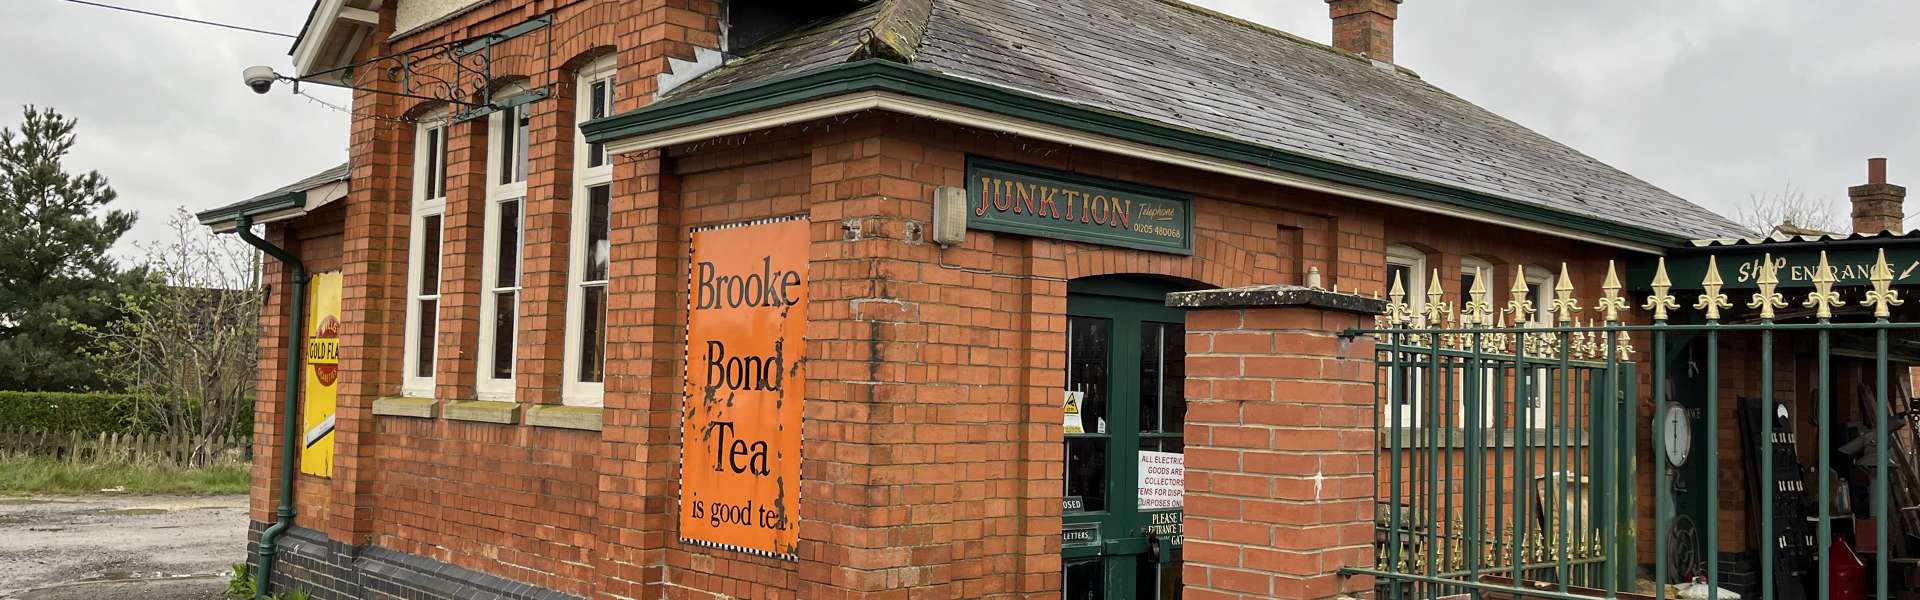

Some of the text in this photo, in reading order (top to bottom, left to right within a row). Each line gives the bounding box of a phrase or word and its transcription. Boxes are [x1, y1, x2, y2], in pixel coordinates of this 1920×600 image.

[975, 175, 1131, 229] JUNKTION
[1137, 202, 1175, 221] Telephone
[1133, 223, 1181, 239] 01205 480068
[1737, 256, 1895, 283] Shp ENRANE
[696, 255, 801, 311] Brooke
[309, 342, 339, 360] GOLD FLA
[706, 340, 784, 392] Bond
[709, 421, 771, 477] Tea
[1141, 455, 1184, 465] ALL ELECTRIC
[1148, 466, 1183, 476] GOODS ARE
[1144, 477, 1184, 486] COLLECTORS
[1138, 487, 1184, 497] TEMS FOR DISPL
[1063, 500, 1081, 509] OSED
[1141, 498, 1181, 507] URPOSES ON
[691, 493, 705, 520] is
[711, 500, 752, 528] good
[1152, 512, 1178, 525] PLEASE
[1063, 531, 1089, 540] LETTERS
[1171, 534, 1184, 545] GAT
